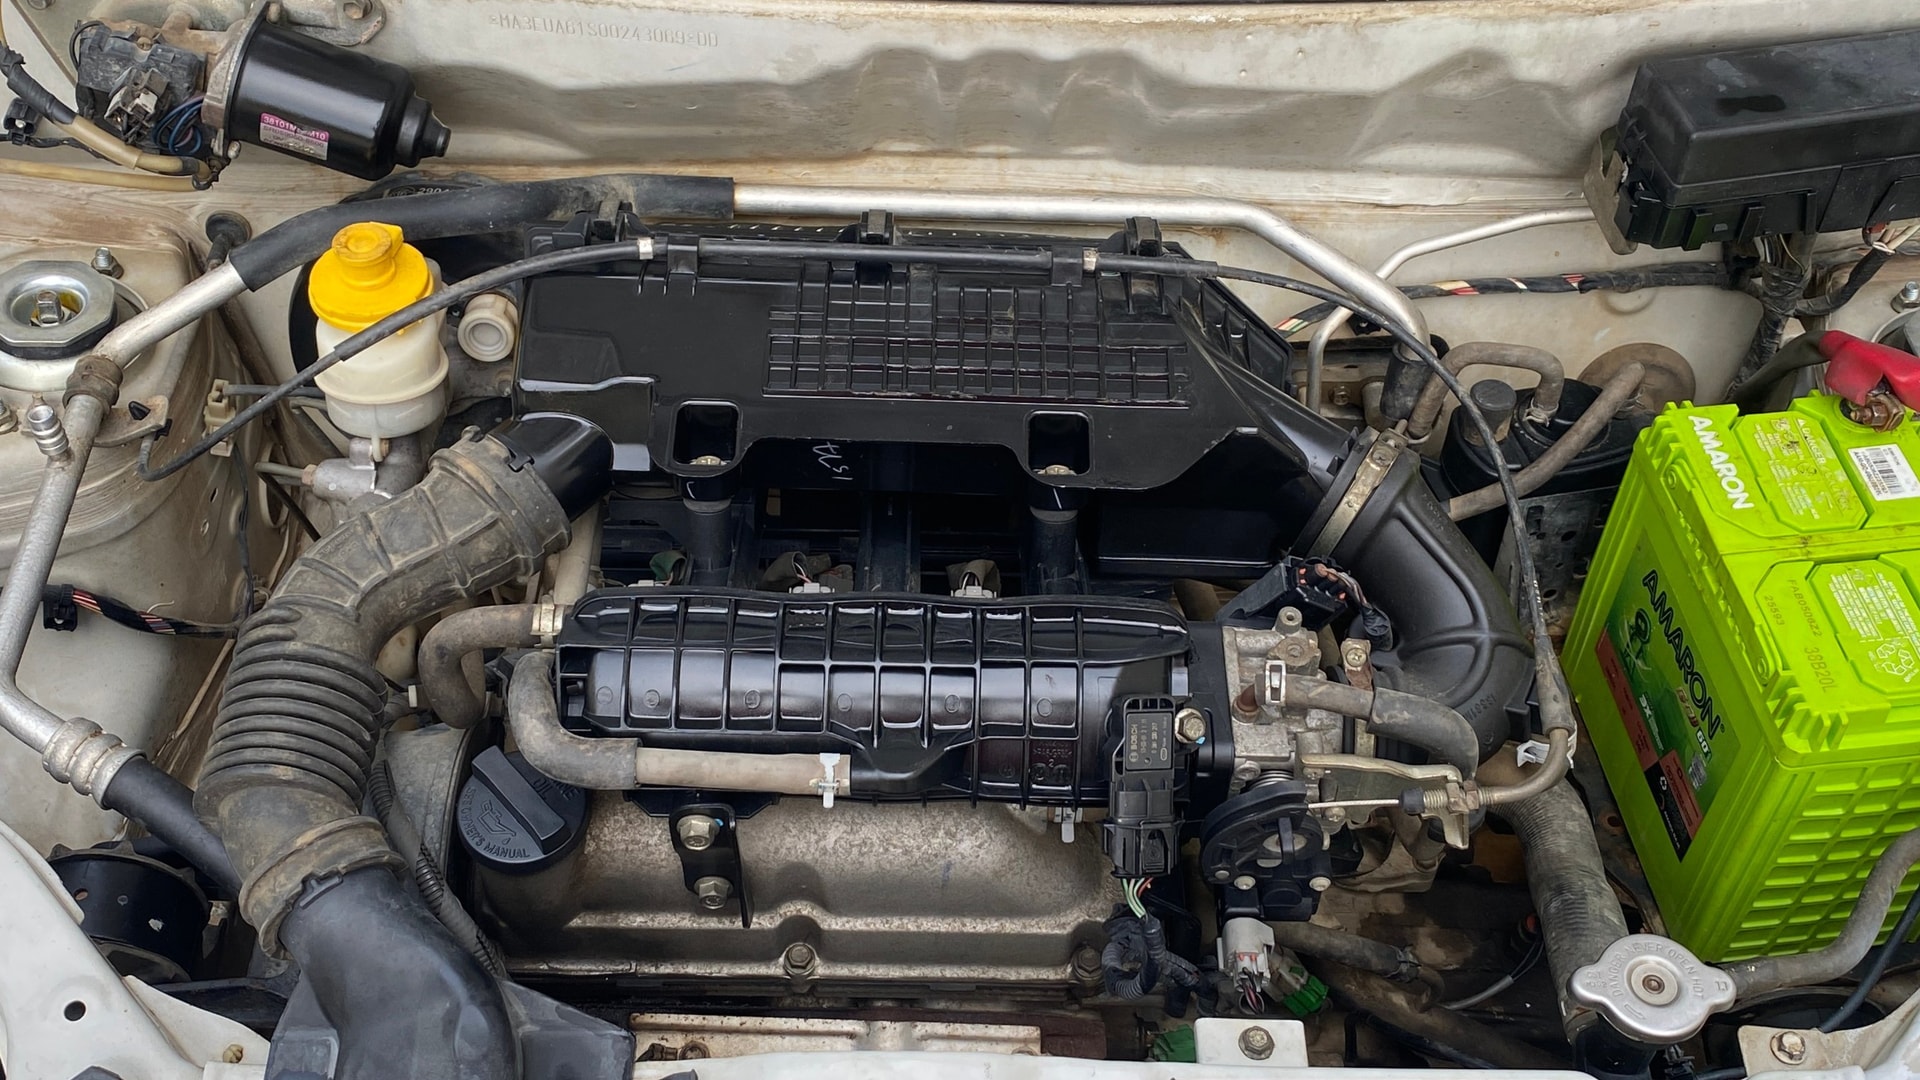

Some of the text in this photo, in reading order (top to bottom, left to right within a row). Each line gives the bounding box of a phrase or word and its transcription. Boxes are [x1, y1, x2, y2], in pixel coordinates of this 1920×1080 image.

[1688, 415, 1755, 510] AMARON
[1800, 426, 1827, 465] DANGER
[1764, 595, 1785, 626] 25593
[1642, 569, 1721, 740] AMARON
[1804, 647, 1838, 693] 38B20L
[1130, 723, 1138, 750] BOSCH
[460, 806, 486, 847] OWNER'S
[483, 841, 531, 859] MANUAL
[1609, 941, 1706, 1000] DANGER NEVER OPEN HOT
